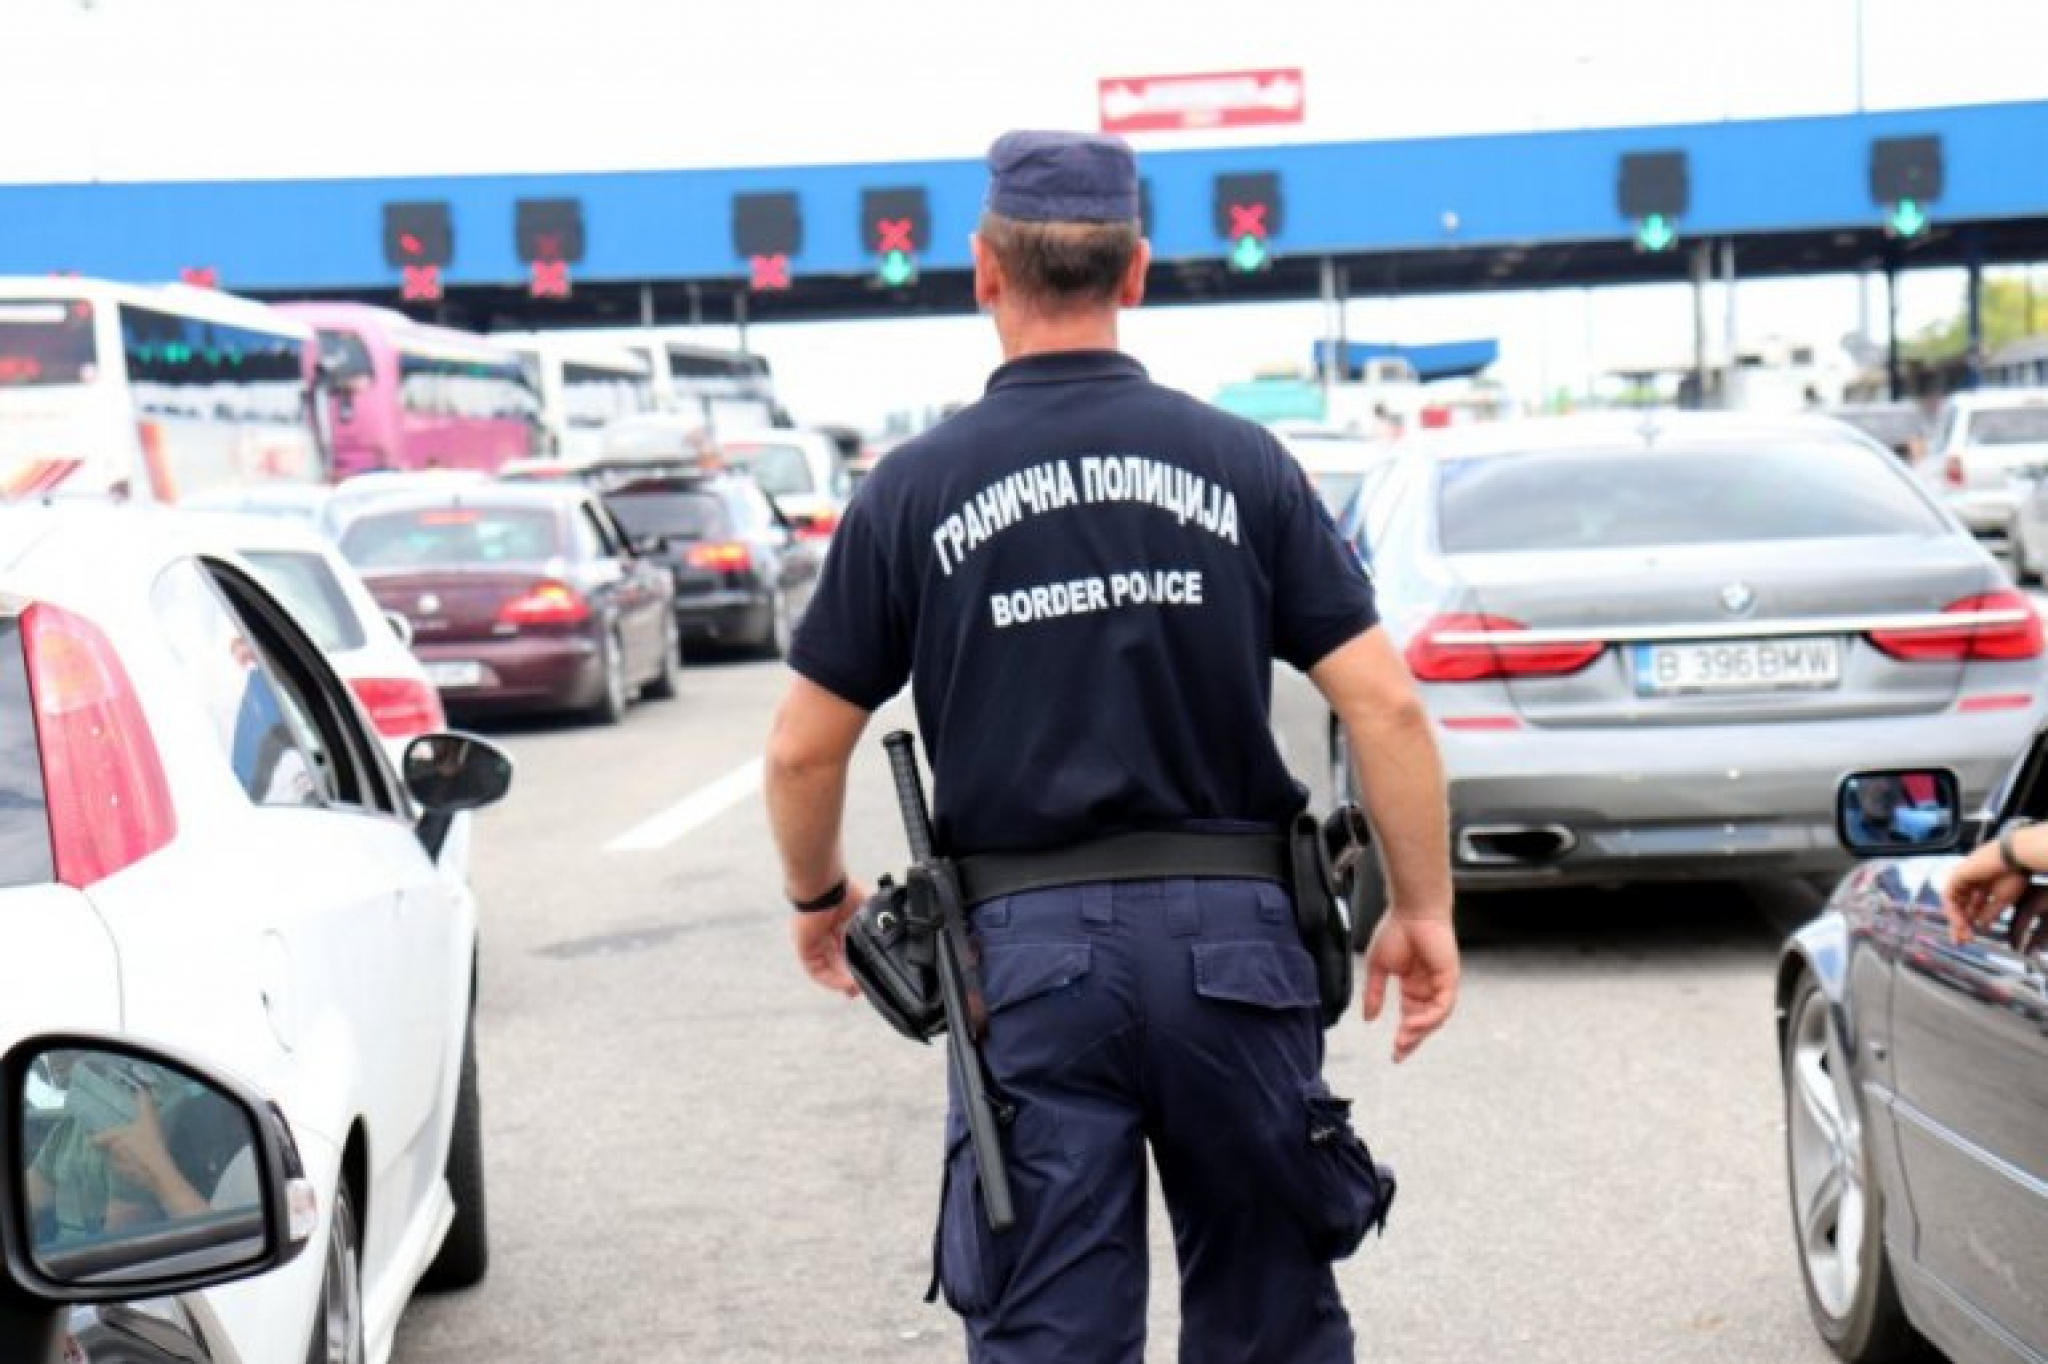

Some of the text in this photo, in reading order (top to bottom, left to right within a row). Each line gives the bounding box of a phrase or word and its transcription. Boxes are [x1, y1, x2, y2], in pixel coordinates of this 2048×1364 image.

[932, 455, 1239, 575] ГРАНИЧНА ПОЛИЦИЈА
[989, 577, 1107, 628] BORDER
[1657, 649, 1680, 682] B
